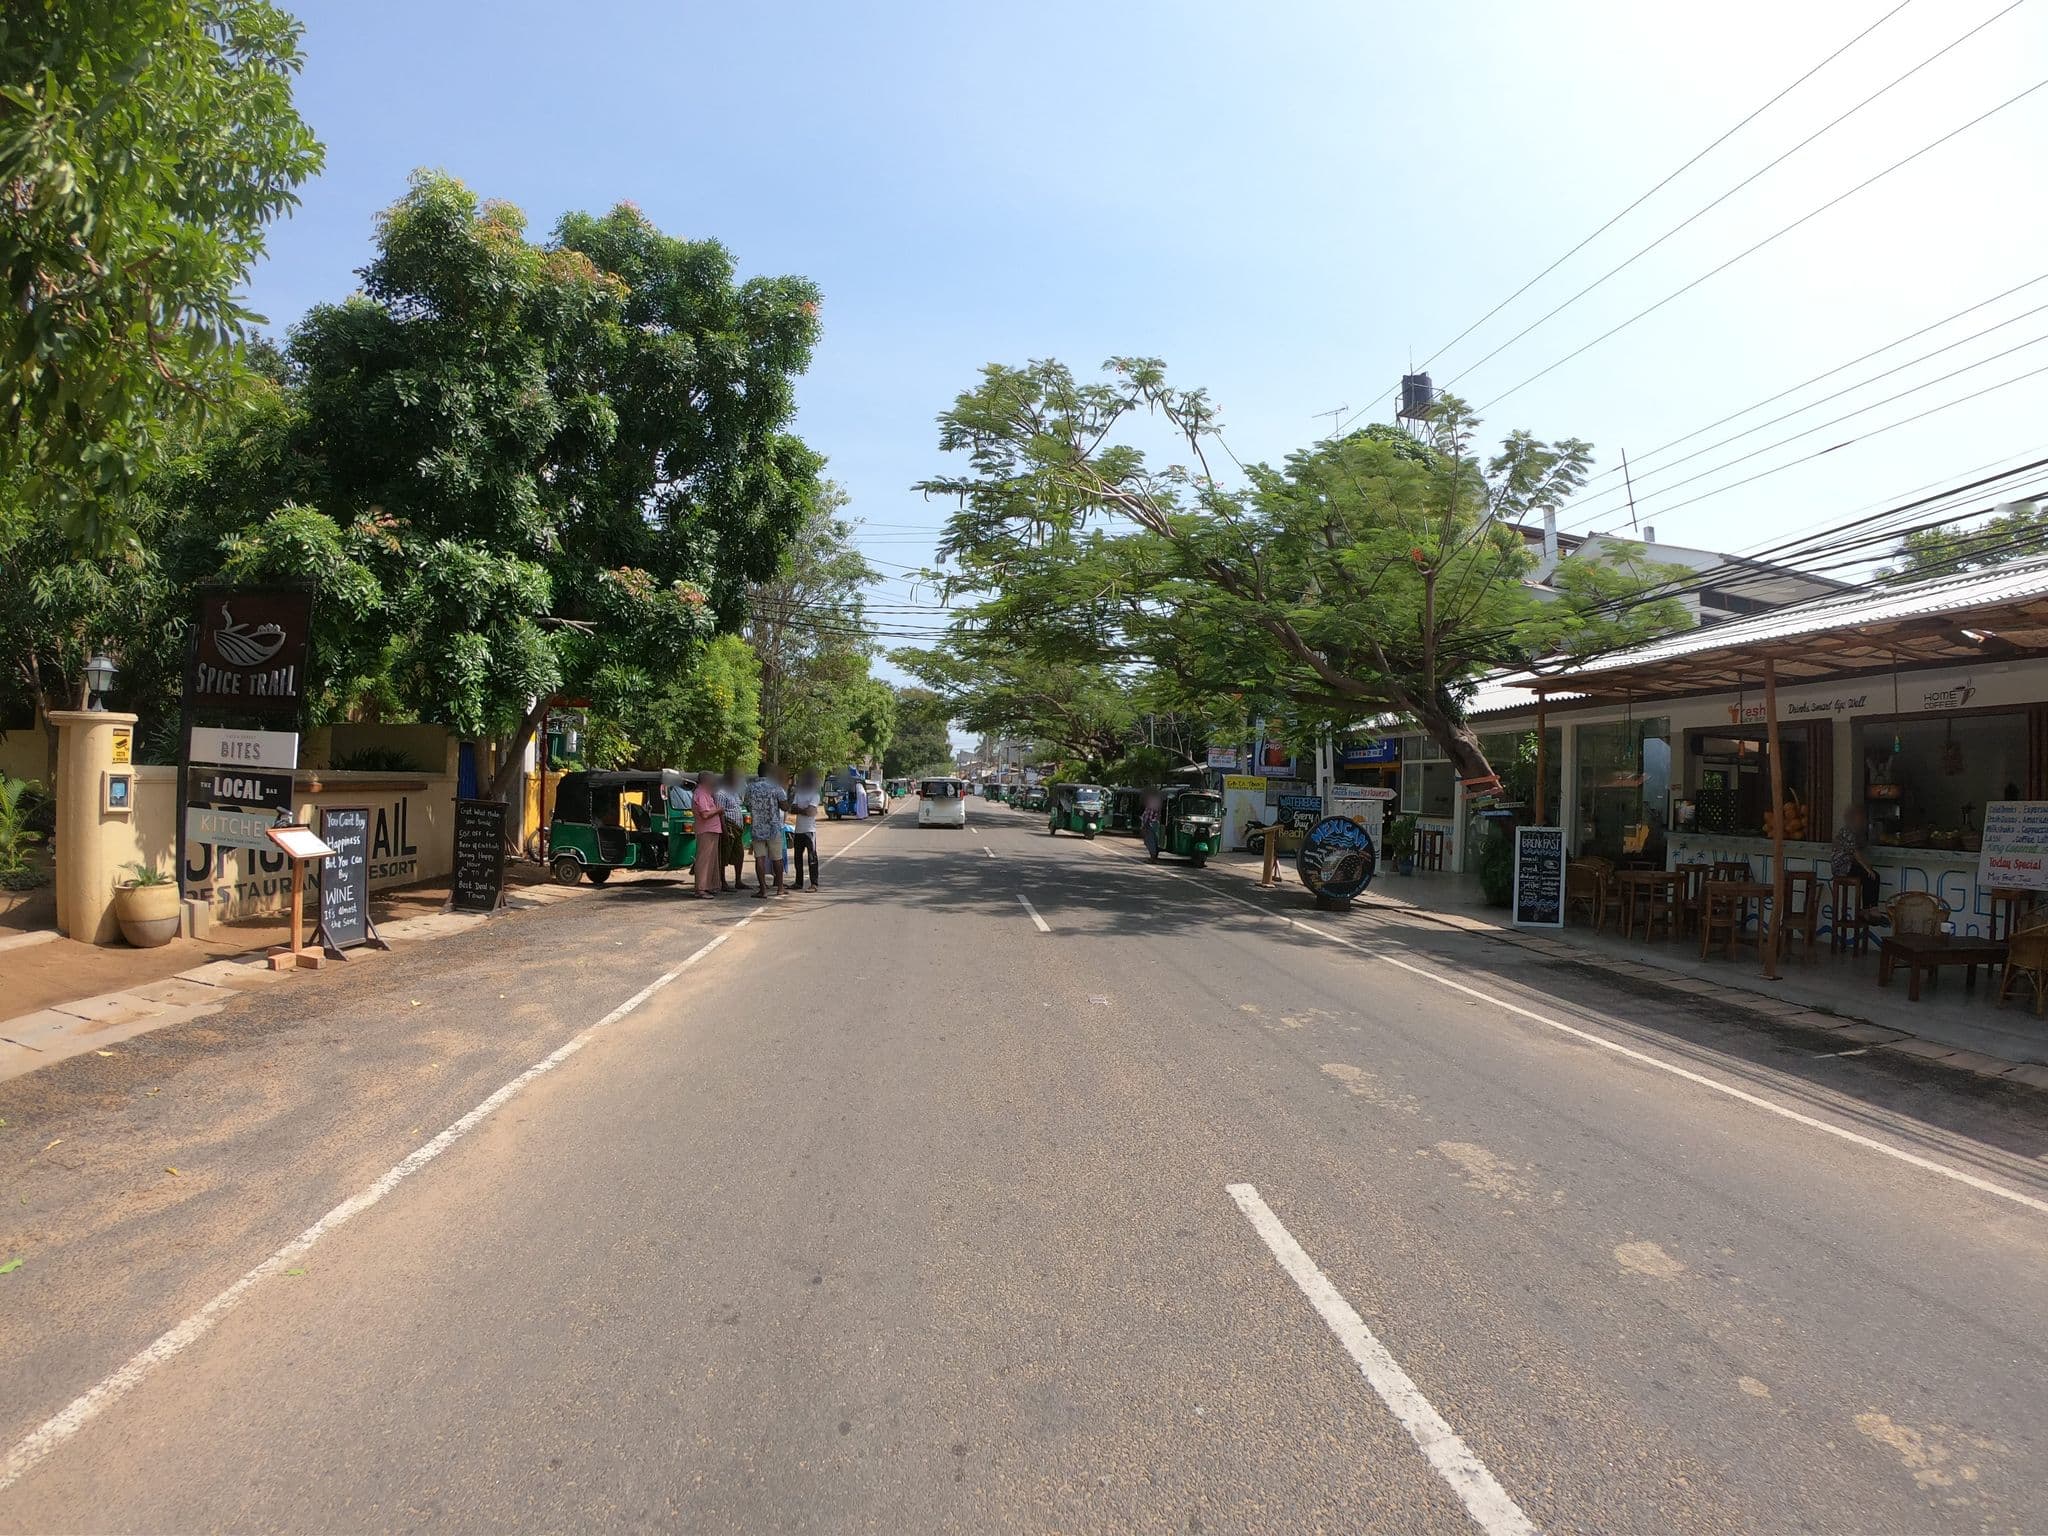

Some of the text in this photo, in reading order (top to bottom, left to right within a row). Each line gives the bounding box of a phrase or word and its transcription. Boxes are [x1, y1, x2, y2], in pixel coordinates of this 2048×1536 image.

[196, 662, 296, 696] SPICE TRAIL
[1924, 700, 1958, 709] COFFEE
[221, 741, 261, 759] BITES
[214, 776, 264, 801] LOCAL
[1293, 811, 1314, 824] Every
[1294, 820, 1310, 833] Day
[372, 797, 417, 859] AIL
[1311, 819, 1369, 850] MEXICAN
[327, 836, 361, 854] Happiness
[1522, 838, 1561, 850] BREAKFAST
[367, 859, 417, 879] ESORT
[1990, 857, 2041, 871] Today Special
[325, 885, 354, 905] WINE
